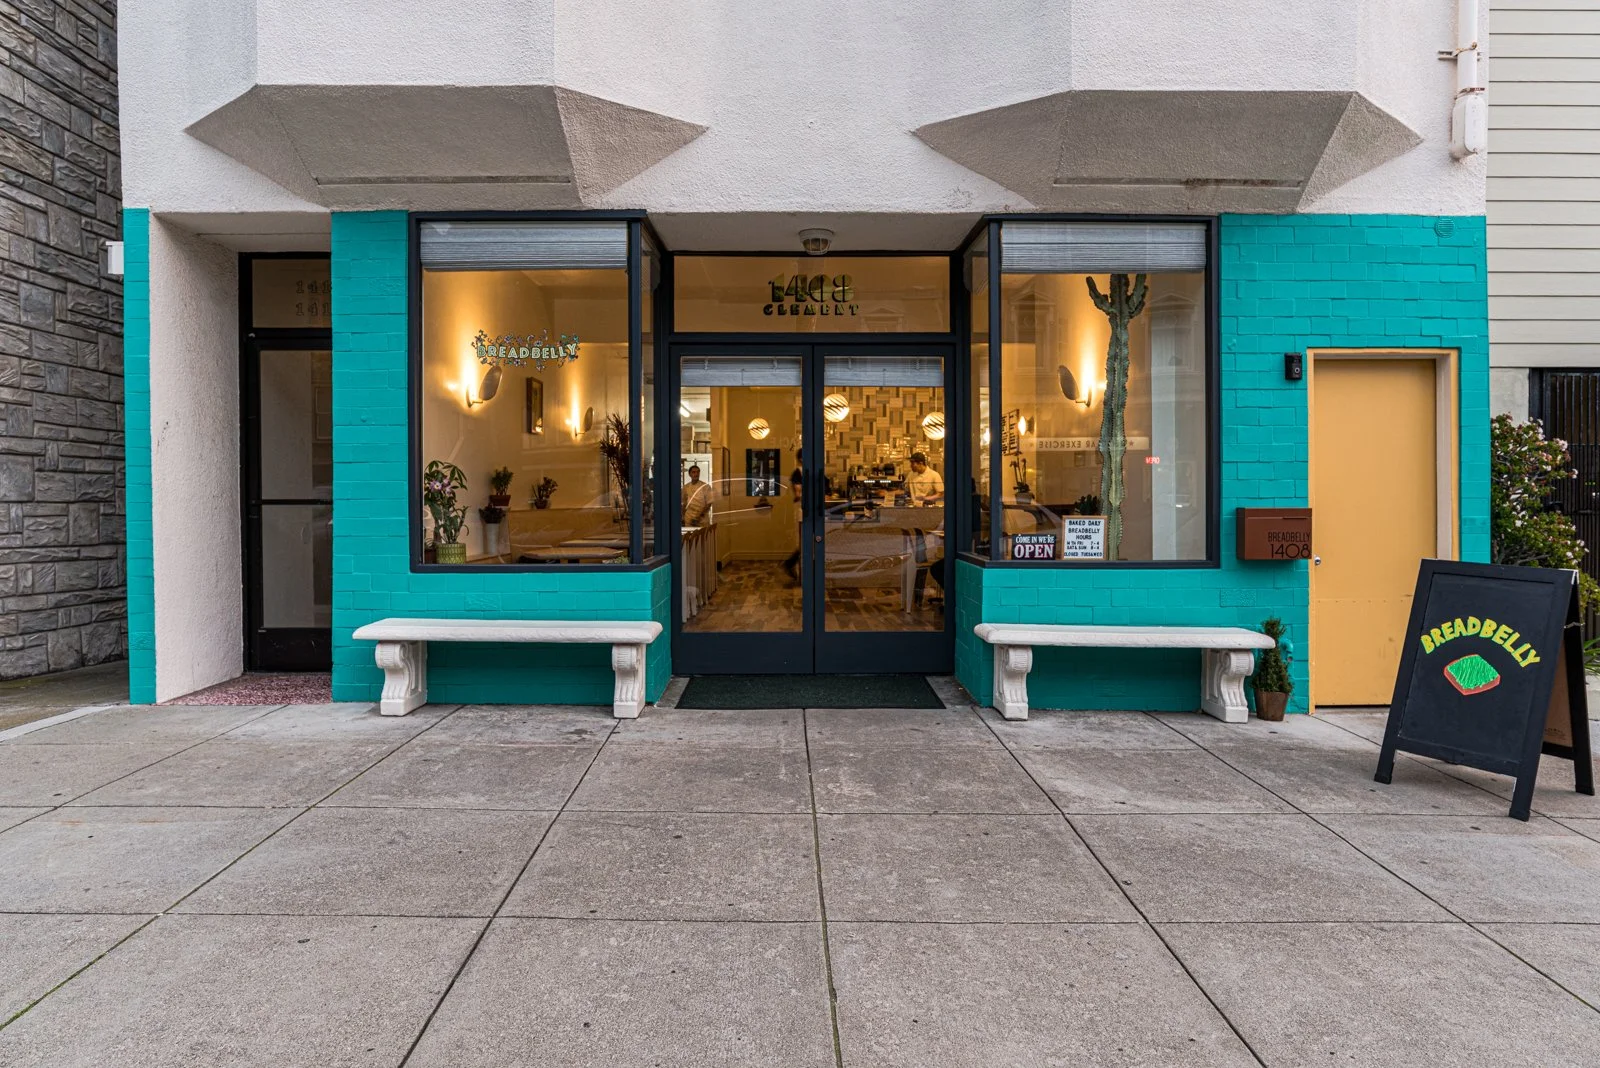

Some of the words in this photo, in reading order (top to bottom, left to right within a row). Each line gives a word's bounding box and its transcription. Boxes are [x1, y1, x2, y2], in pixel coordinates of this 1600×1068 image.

[768, 273, 854, 303] 1408
[763, 304, 859, 316] CLEMENT
[476, 343, 577, 359] BREADBELLY
[1015, 535, 1031, 544] COME
[1267, 531, 1311, 543] BREADBELLY
[1014, 544, 1054, 558] OPEN
[1270, 543, 1311, 559] 1408
[1420, 615, 1541, 668] BREADBELLY
